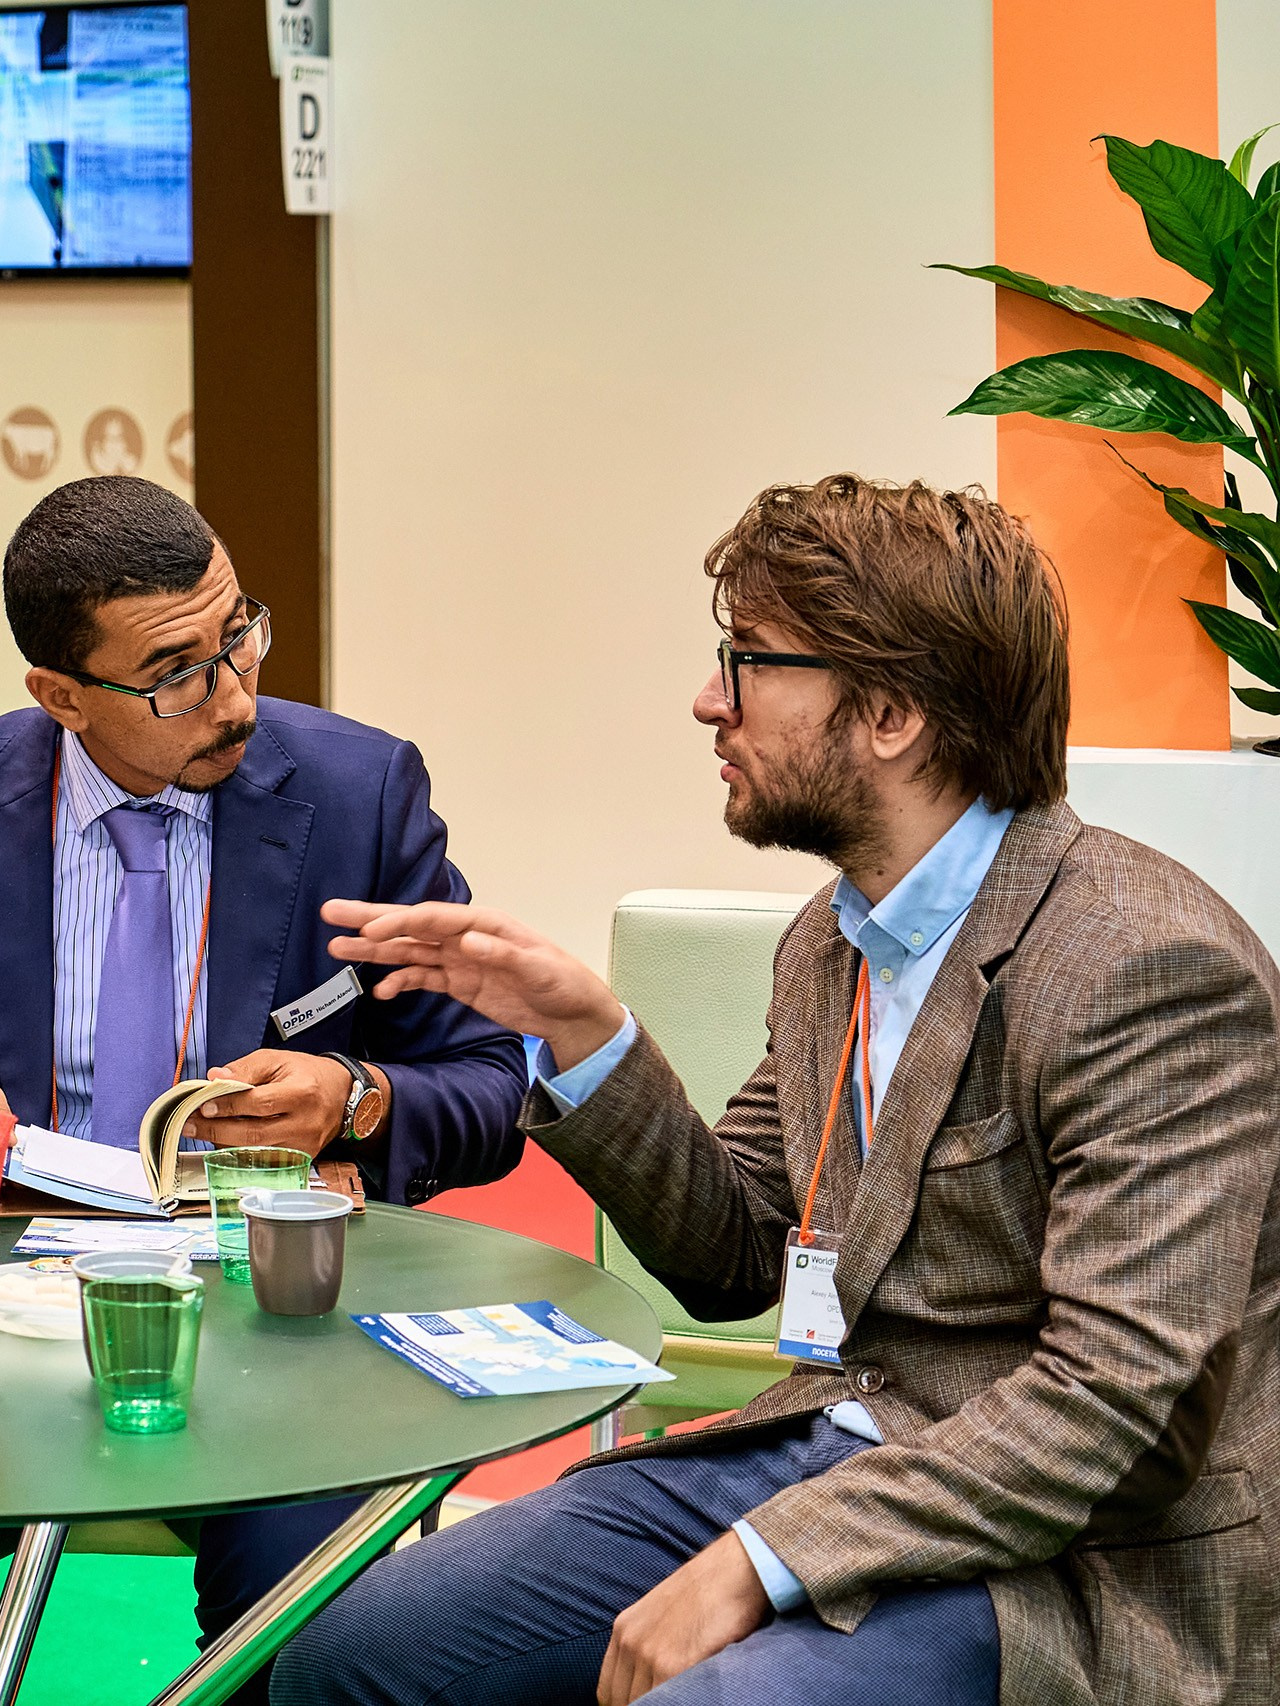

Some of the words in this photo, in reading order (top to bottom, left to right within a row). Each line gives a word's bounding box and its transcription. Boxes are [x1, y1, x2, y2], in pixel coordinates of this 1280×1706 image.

[299, 93, 320, 140] D
[292, 150, 327, 181] 221
[282, 1009, 314, 1030] OPDR
[811, 1255, 837, 1266] WorldF
[827, 1304, 840, 1314] OPD
